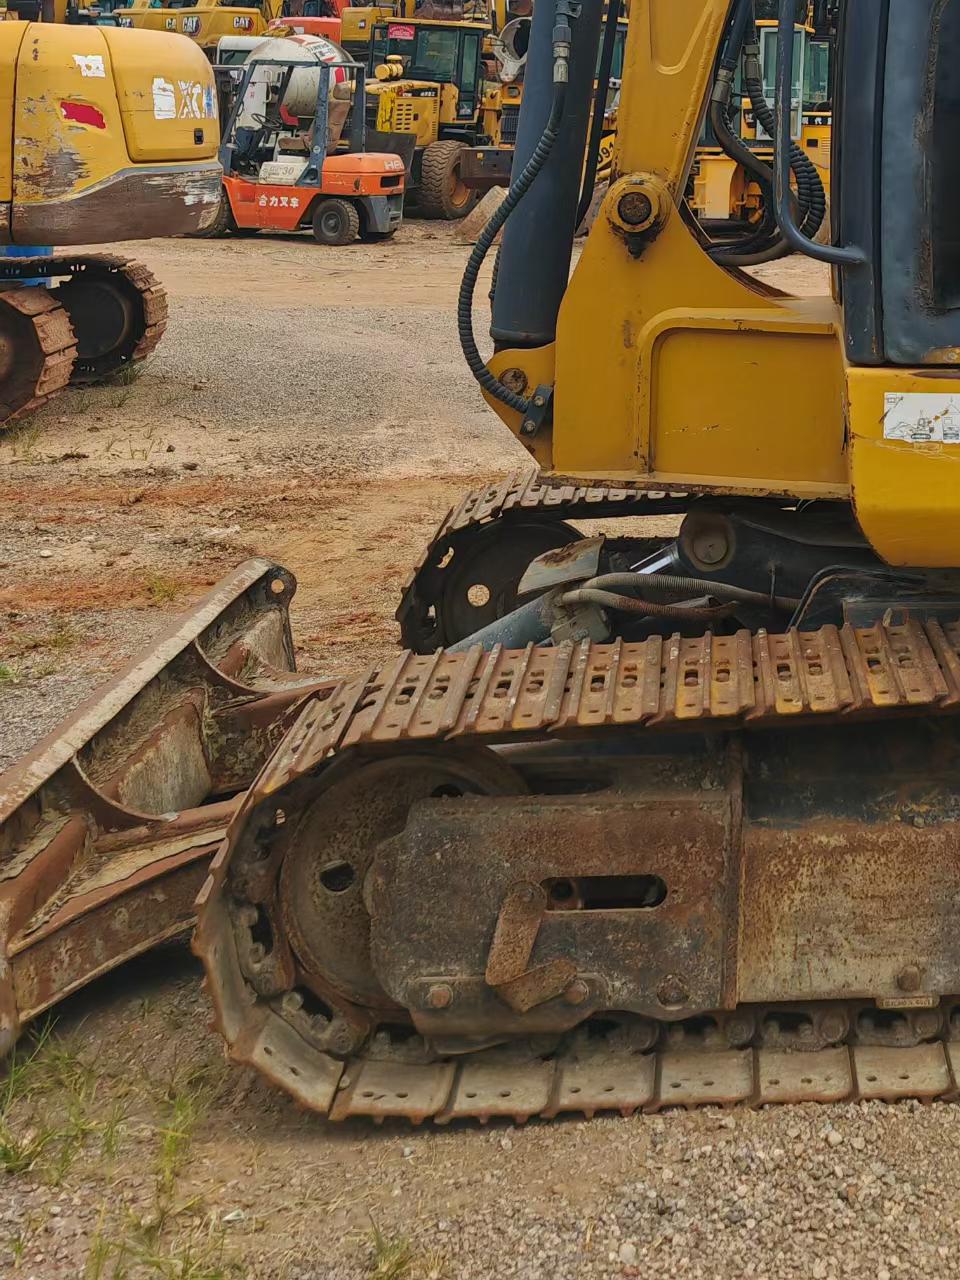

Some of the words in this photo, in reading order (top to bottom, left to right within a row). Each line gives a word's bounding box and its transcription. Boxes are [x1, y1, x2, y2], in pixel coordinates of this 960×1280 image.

[182, 17, 198, 33] CAT
[233, 16, 250, 29] CAT
[258, 194, 300, 208] 合力叉车
